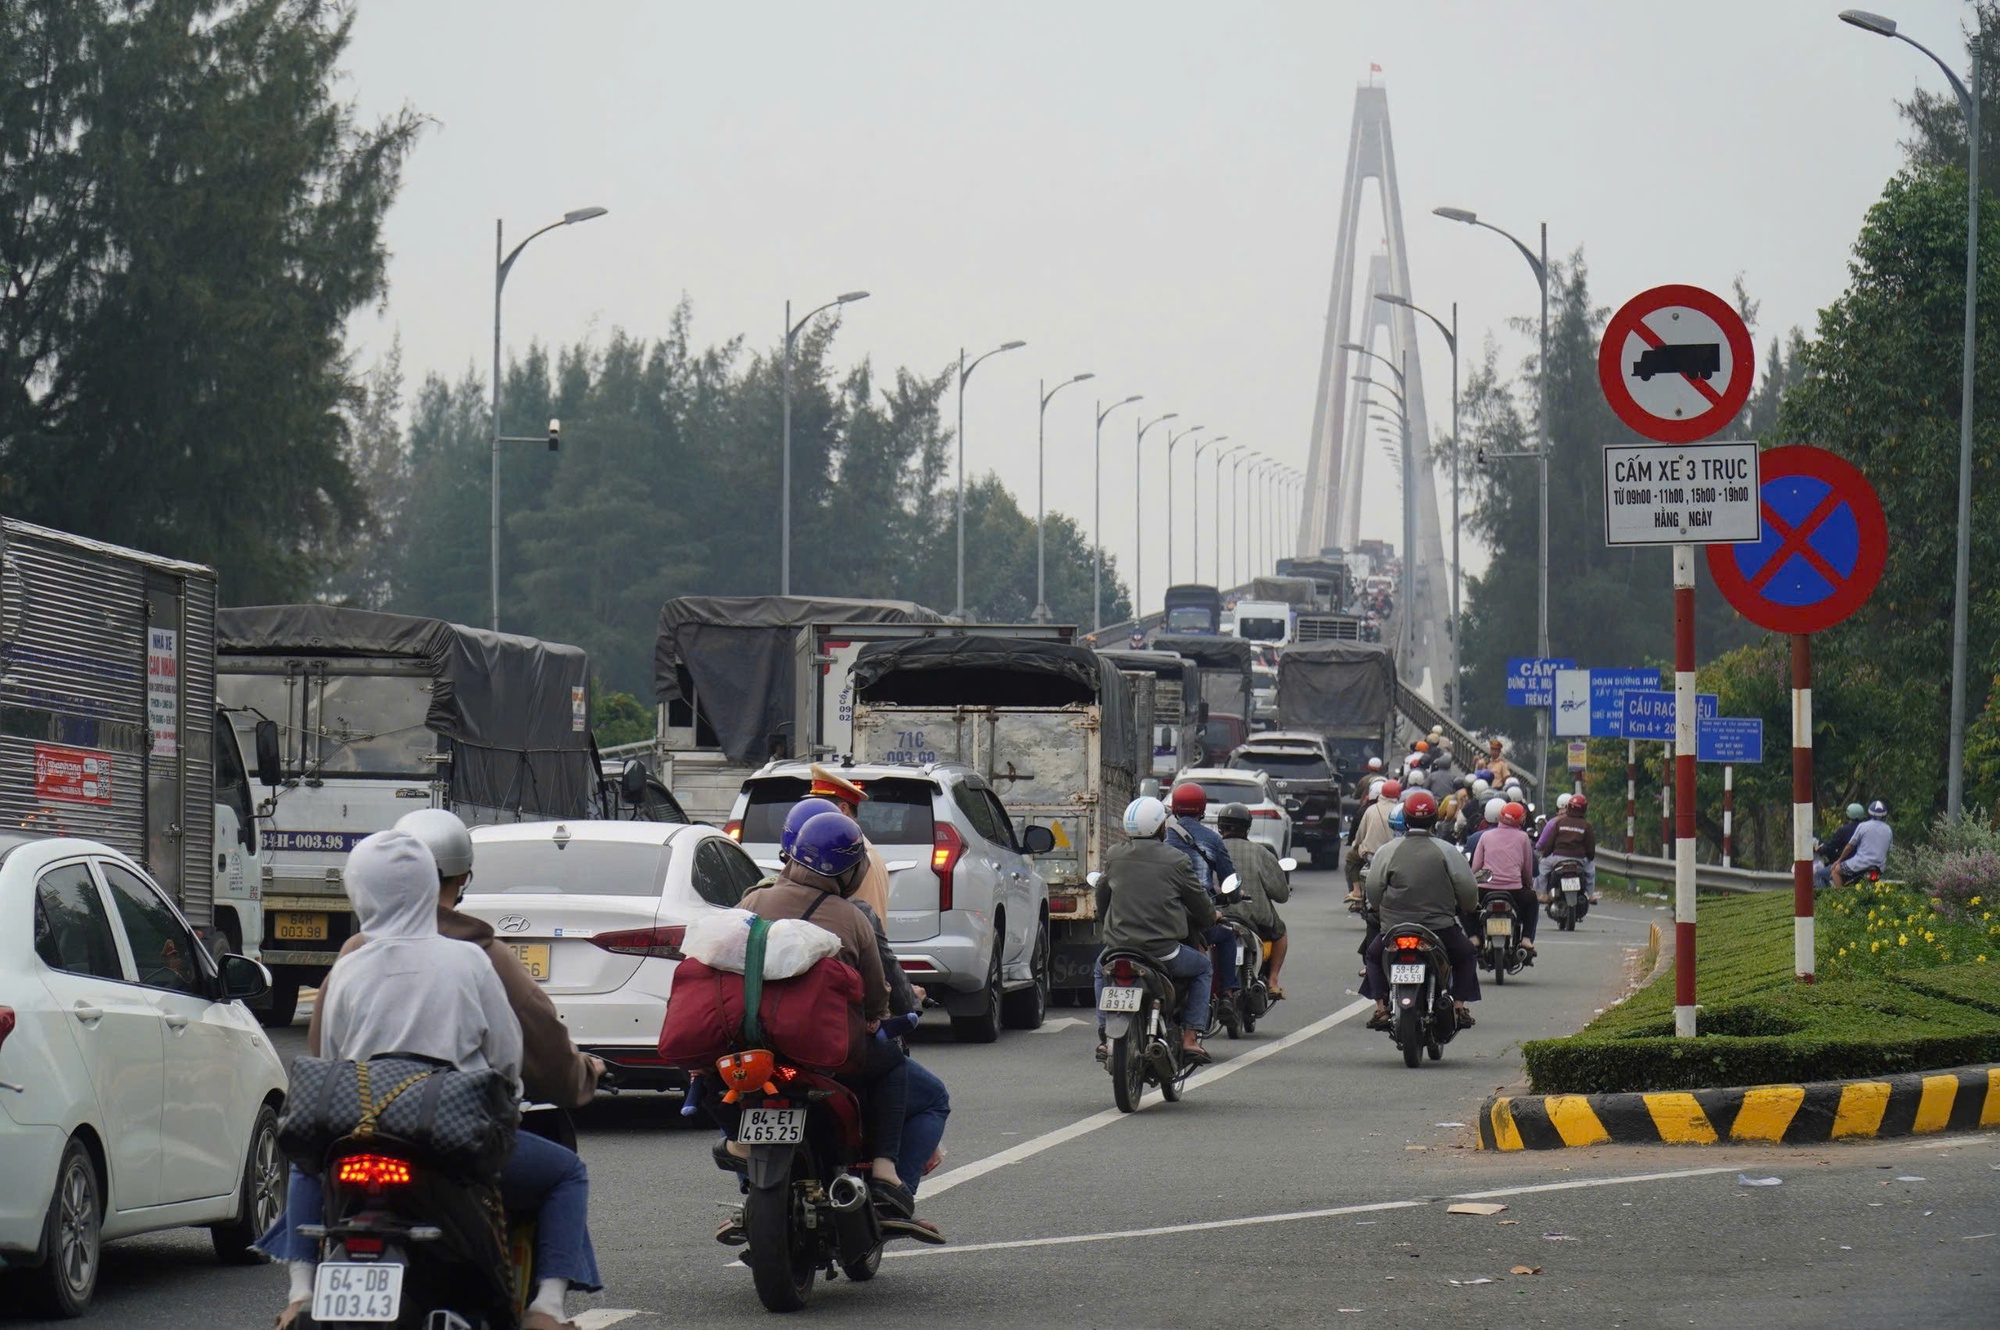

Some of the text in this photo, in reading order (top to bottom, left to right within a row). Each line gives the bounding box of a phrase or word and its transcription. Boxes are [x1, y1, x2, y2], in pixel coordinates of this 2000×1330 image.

[1615, 454, 1747, 484] CẤM XE 3 TRỤC
[1614, 487, 1624, 505] TỪ
[1626, 489, 1651, 505] 09h00
[1660, 488, 1683, 504] 11h00
[1691, 487, 1716, 503] 15h00
[1724, 486, 1748, 502] 19h00
[1654, 506, 1712, 528] HẰNG NGÀY
[1653, 701, 1676, 719] RẠC
[897, 731, 924, 748] 71C
[290, 914, 313, 925] 64H
[281, 926, 322, 938] 003.98
[751, 1111, 794, 1125] 84-E1
[743, 1126, 800, 1141] 465.25
[331, 1268, 390, 1292] 64-DB
[323, 1294, 392, 1318] 103.43
